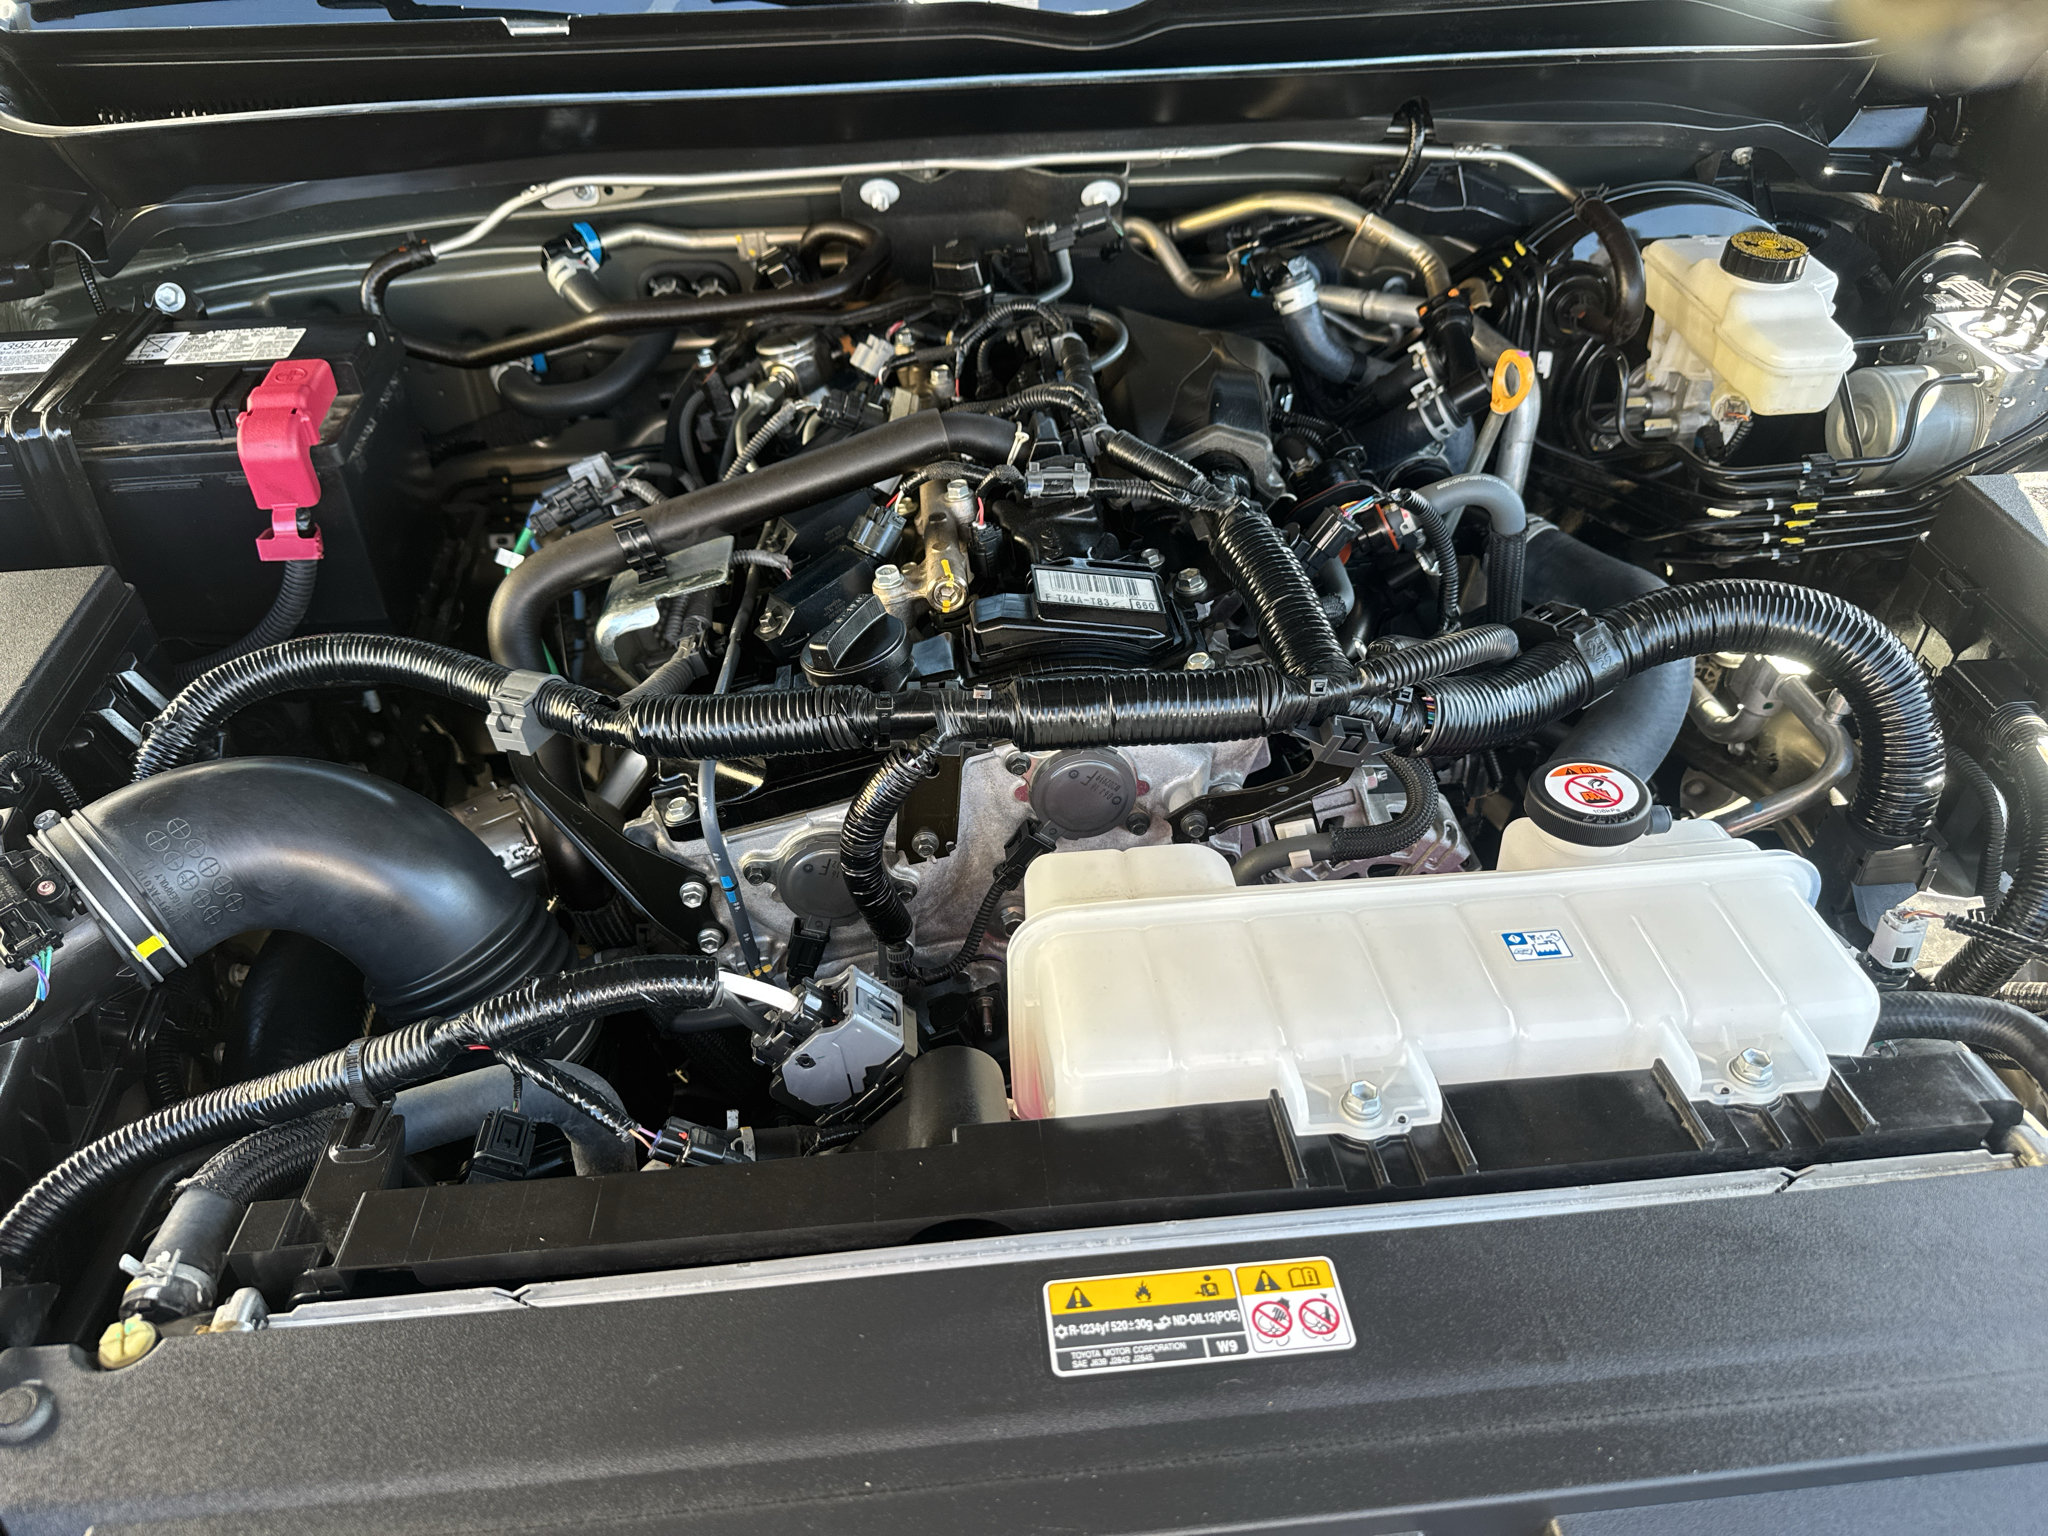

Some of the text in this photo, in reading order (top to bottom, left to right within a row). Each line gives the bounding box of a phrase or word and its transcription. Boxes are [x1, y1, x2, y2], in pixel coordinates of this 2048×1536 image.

[1068, 1320, 1110, 1337] R-1234yf
[1172, 1309, 1241, 1328] ND-OIL12(POE)
[1071, 1339, 1238, 1360] TOYOTA MOTOR CORPORATION W9
[1071, 1358, 1089, 1368] SAE
